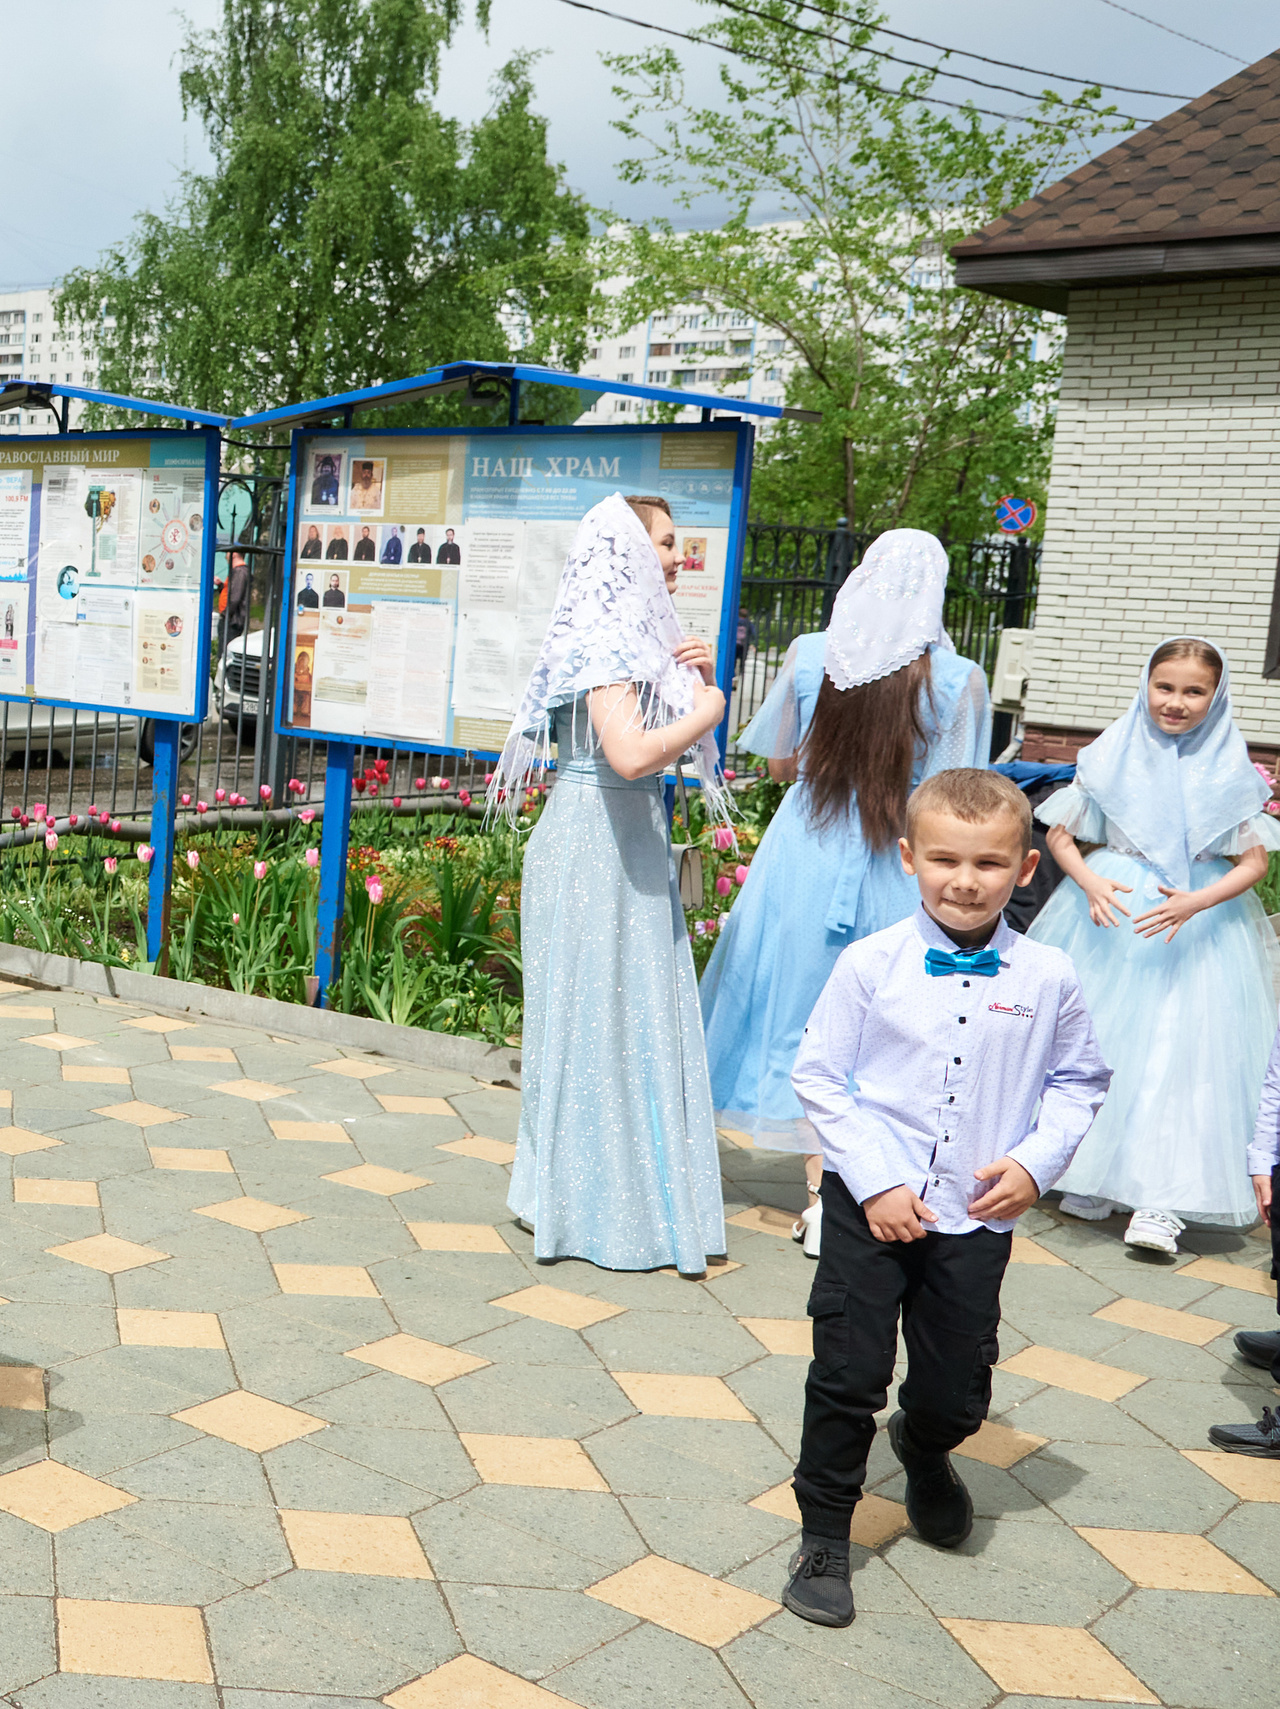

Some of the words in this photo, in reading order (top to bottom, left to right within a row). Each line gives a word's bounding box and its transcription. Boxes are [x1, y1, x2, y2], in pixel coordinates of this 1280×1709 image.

[91, 449, 120, 464] МИР
[471, 456, 534, 478] НАШ
[544, 456, 621, 478] ХРАМ
